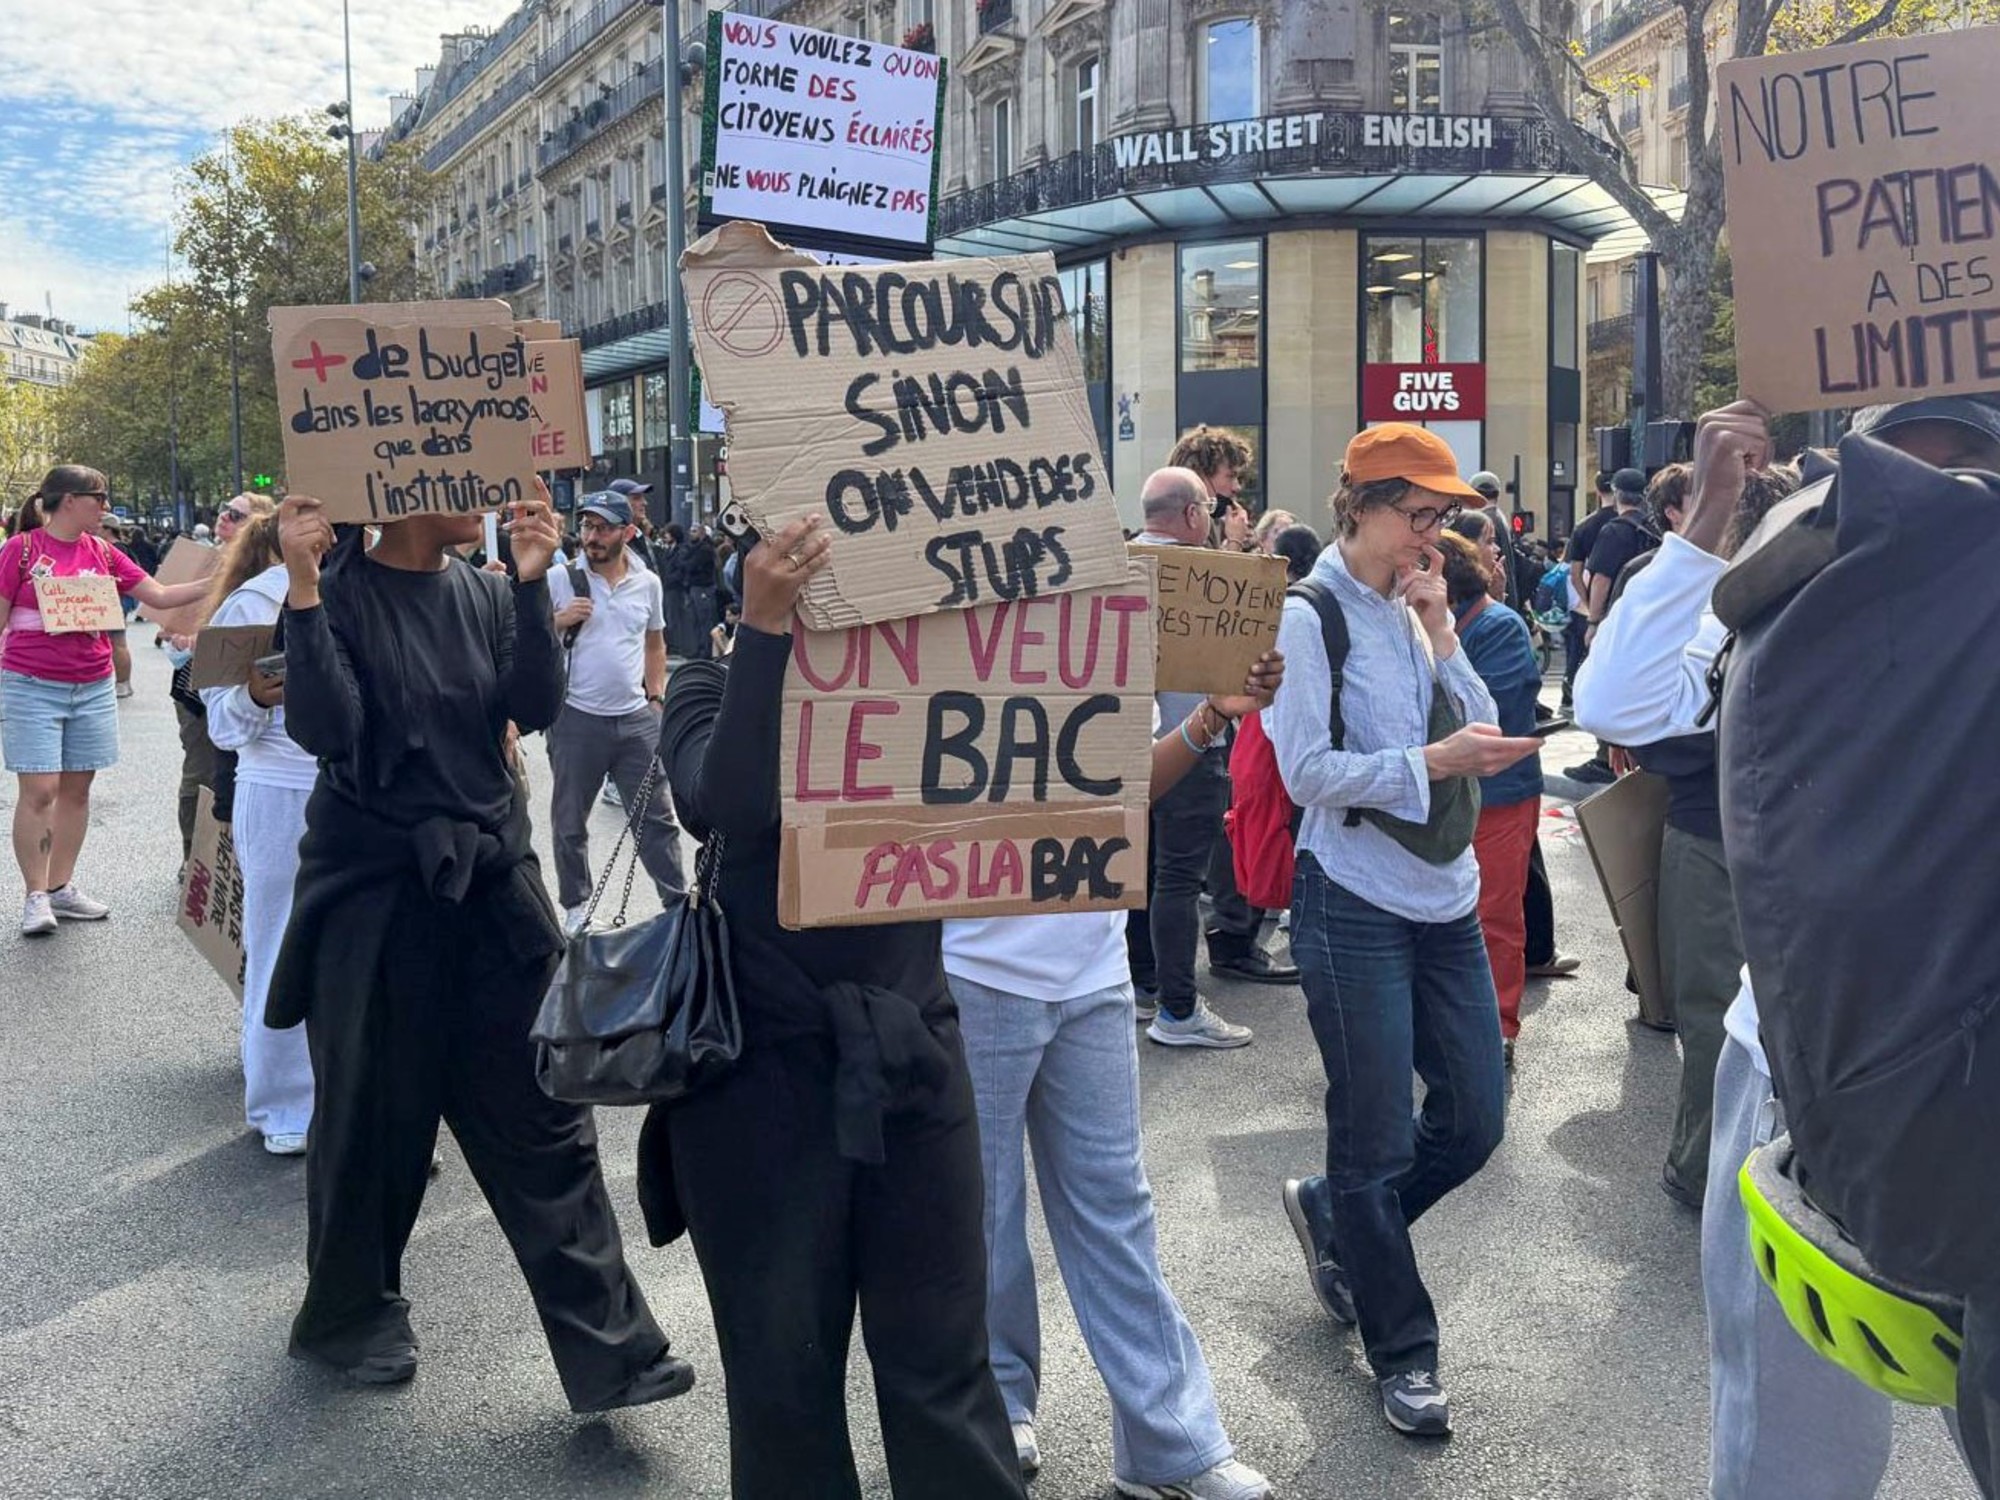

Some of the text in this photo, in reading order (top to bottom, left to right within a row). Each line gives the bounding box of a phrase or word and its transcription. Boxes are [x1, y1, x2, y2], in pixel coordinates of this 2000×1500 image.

[725, 21, 938, 80] VOUS VOULEZ QU'ON
[723, 58, 856, 102] FORME DES
[1730, 53, 1939, 165] NOTRE
[1113, 113, 1492, 169] WALL STREET ENGLISH
[716, 163, 740, 189] NE
[746, 169, 791, 193] VOUS
[891, 190, 927, 214] PAS
[1867, 256, 1994, 313] A DES
[780, 270, 1067, 359] PARCOURSUP
[353, 328, 409, 380] de
[419, 327, 526, 390] budget
[1815, 307, 2000, 394] LIMITE
[291, 385, 360, 434] dans
[363, 389, 404, 427] les
[1393, 391, 1460, 411] GUYS
[1400, 371, 1453, 390] FIVE
[374, 426, 473, 469] que dans
[366, 468, 522, 519] l'institution
[909, 457, 1029, 523] VEND
[1028, 453, 1096, 509] DES
[925, 526, 1072, 607] STUPS
[1186, 566, 1284, 609] MOYENS
[793, 593, 1150, 692] ON VEUT
[795, 690, 1123, 805] LE BAC
[854, 837, 1131, 909] PAS LA BAC
